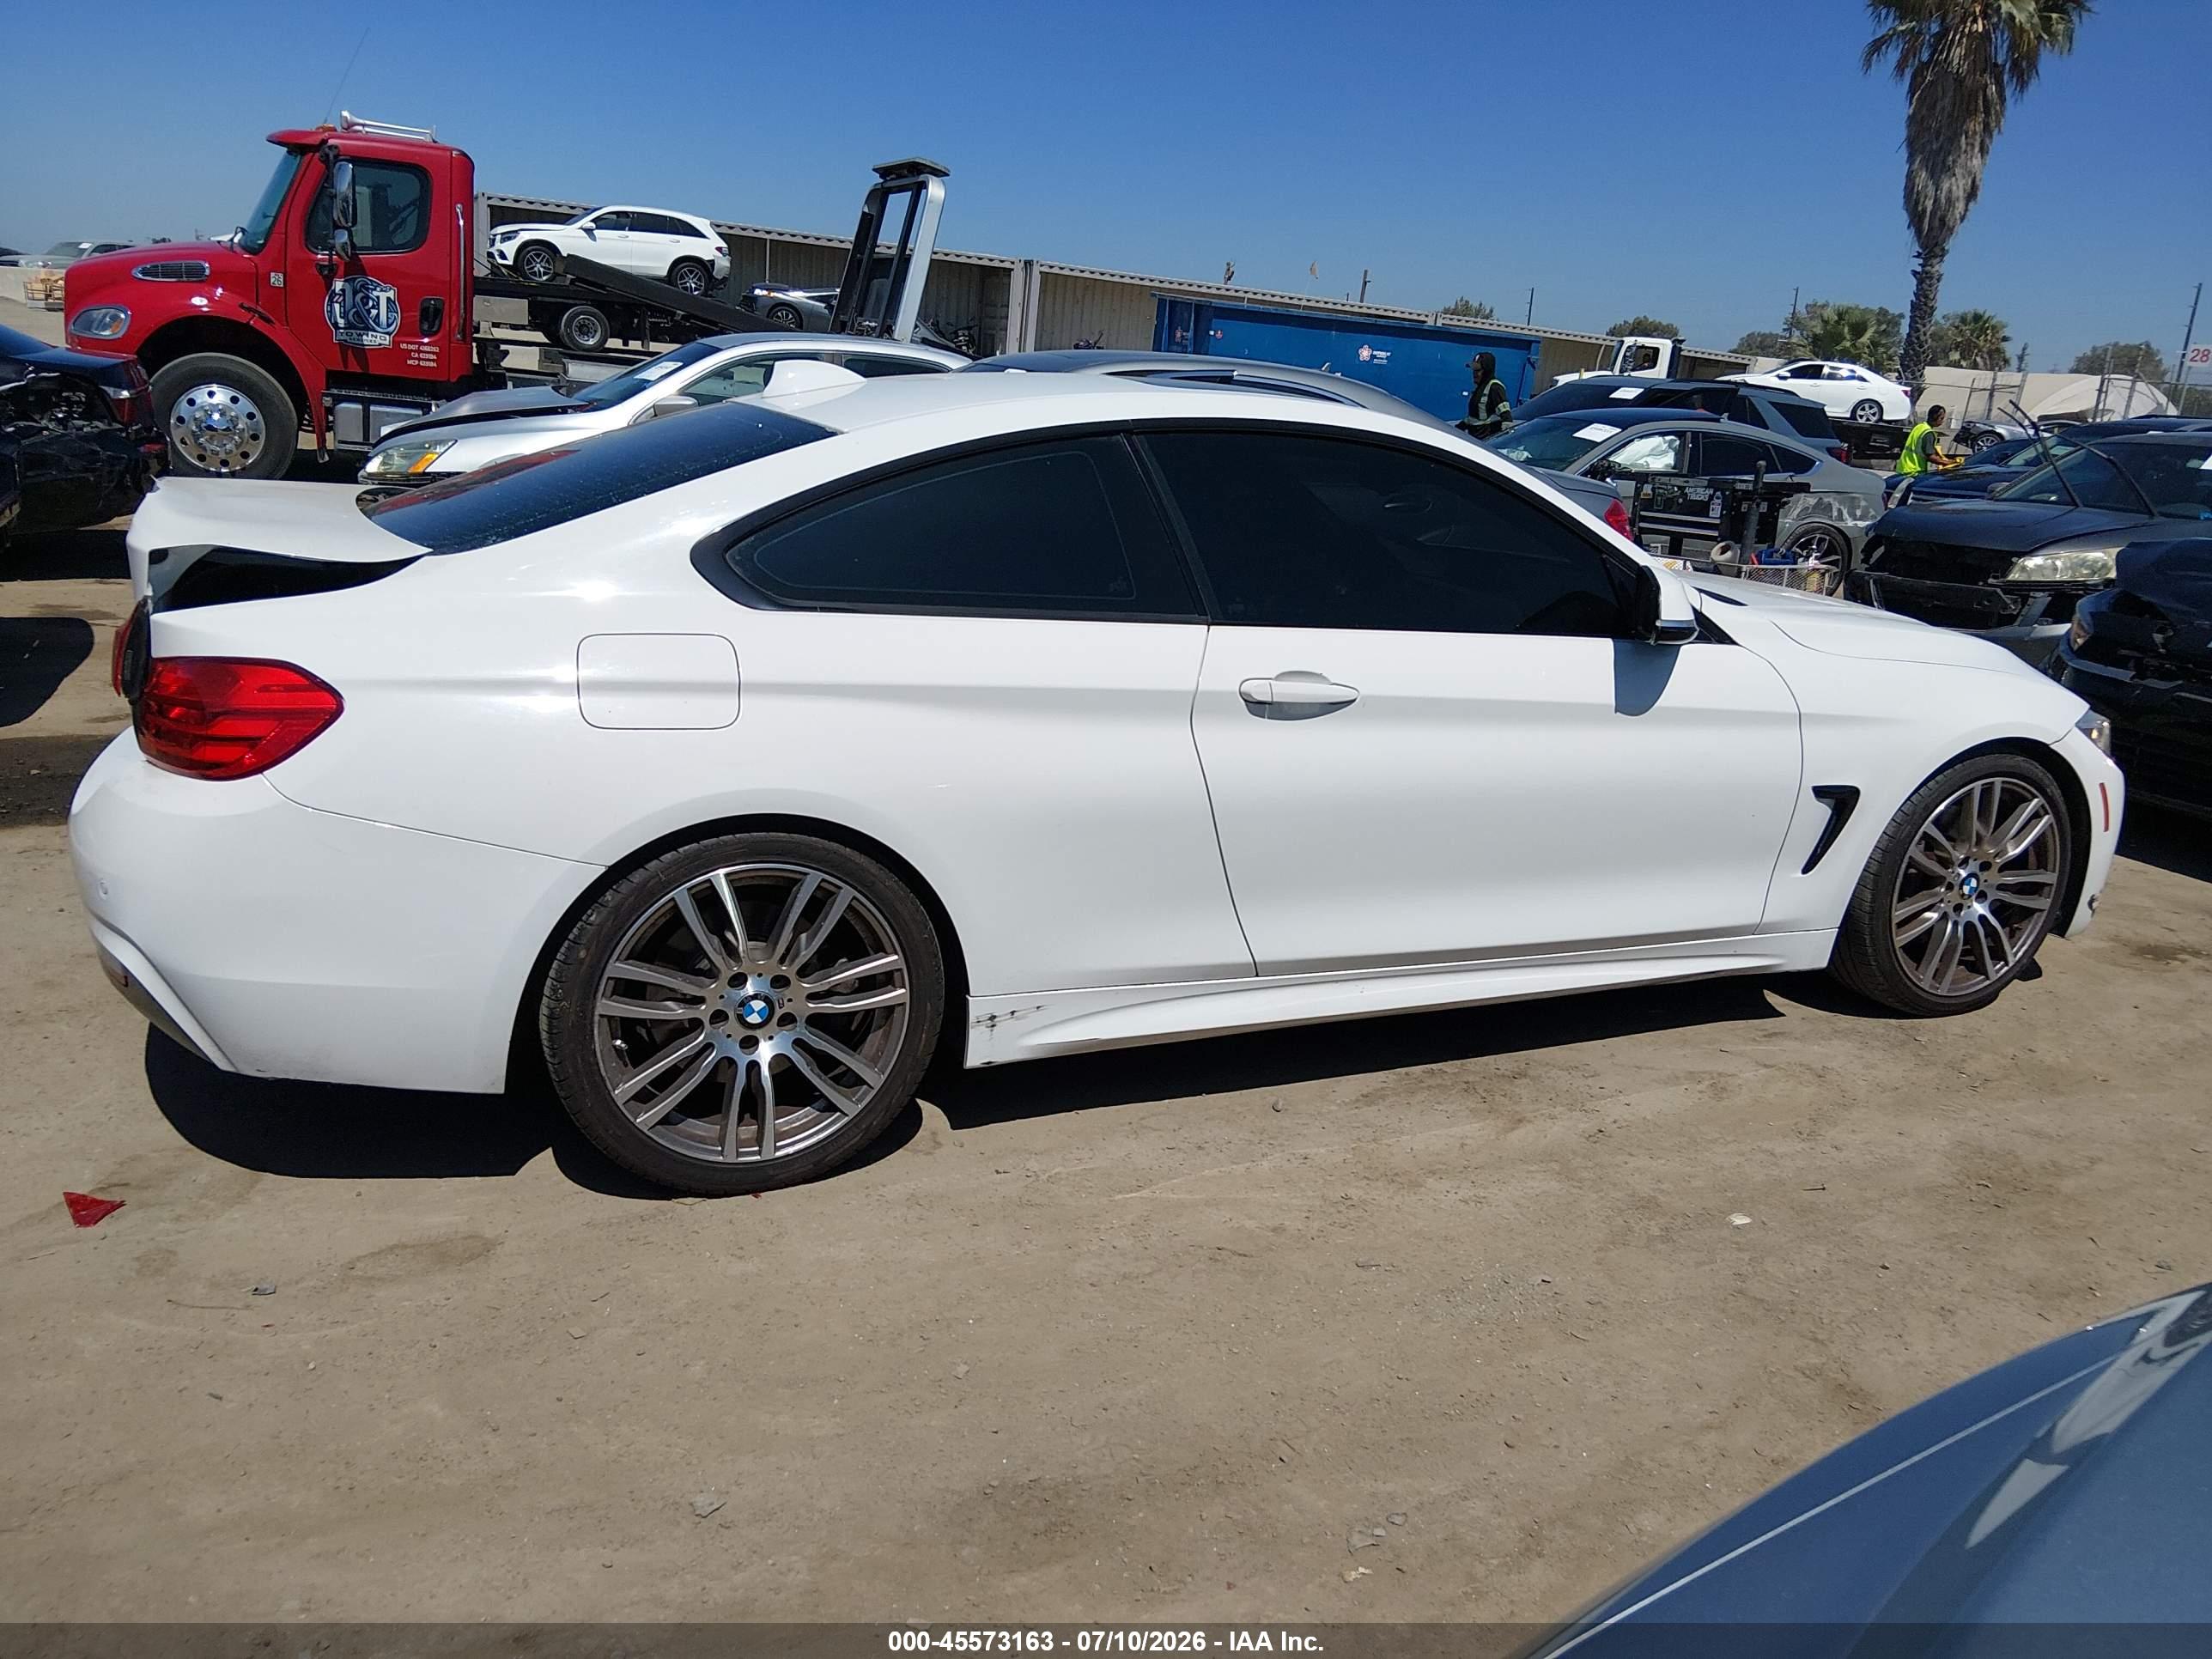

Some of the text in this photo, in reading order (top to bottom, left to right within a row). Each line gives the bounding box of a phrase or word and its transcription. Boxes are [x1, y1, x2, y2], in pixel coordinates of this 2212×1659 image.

[338, 331, 389, 342] TOWING
[2190, 348, 2211, 363] 28
[1683, 486, 1714, 495] AMERICAN
[1686, 493, 1709, 501] TRUCKS
